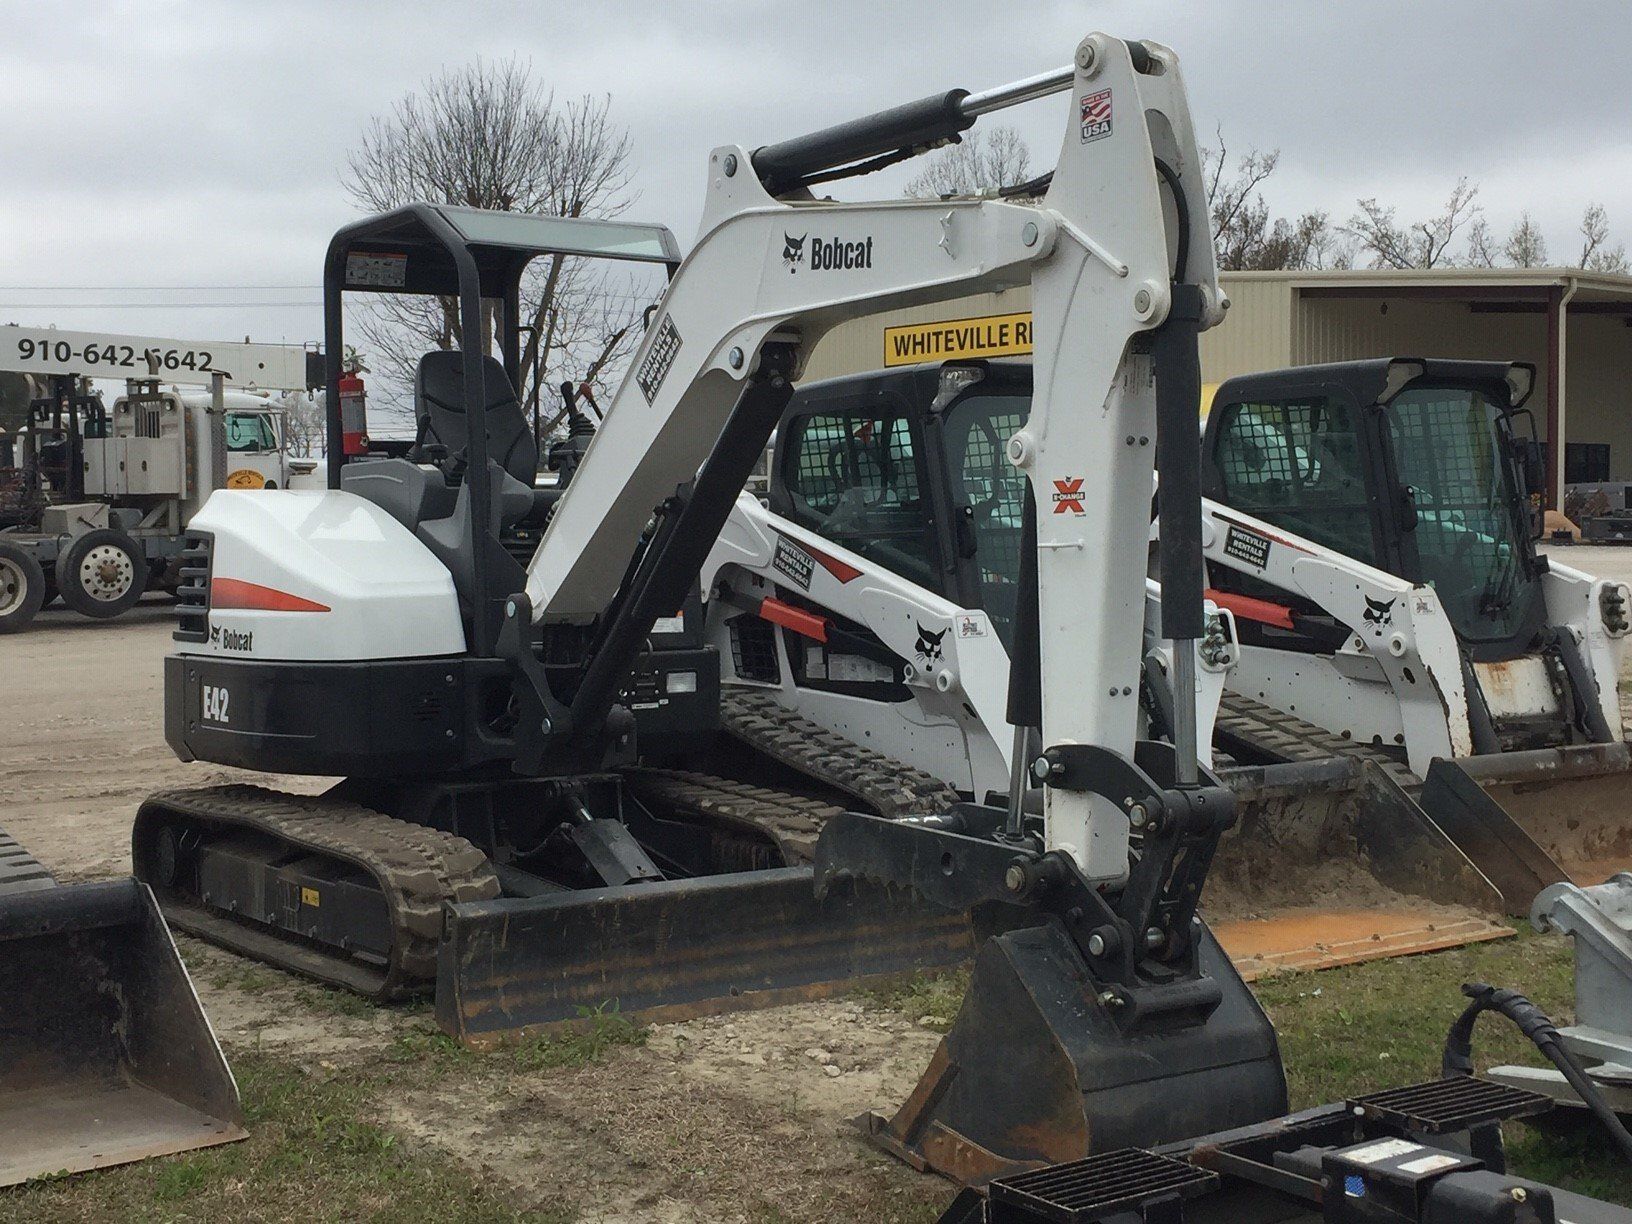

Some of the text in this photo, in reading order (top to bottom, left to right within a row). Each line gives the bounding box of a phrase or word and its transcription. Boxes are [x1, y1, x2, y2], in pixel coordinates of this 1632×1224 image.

[1083, 121, 1110, 138] USA
[811, 236, 873, 270] Bobcat
[638, 318, 672, 383] WHITEVILLE
[894, 323, 1009, 357] WHITEVILLE
[646, 334, 672, 385] RENTALS
[778, 539, 814, 570] WHITEVILLE
[1231, 529, 1267, 550] WHITEVILLE
[1233, 539, 1263, 557] RENTALS
[780, 550, 807, 575] RENTALS
[223, 628, 253, 651] Bobcat
[203, 685, 229, 723] E42
